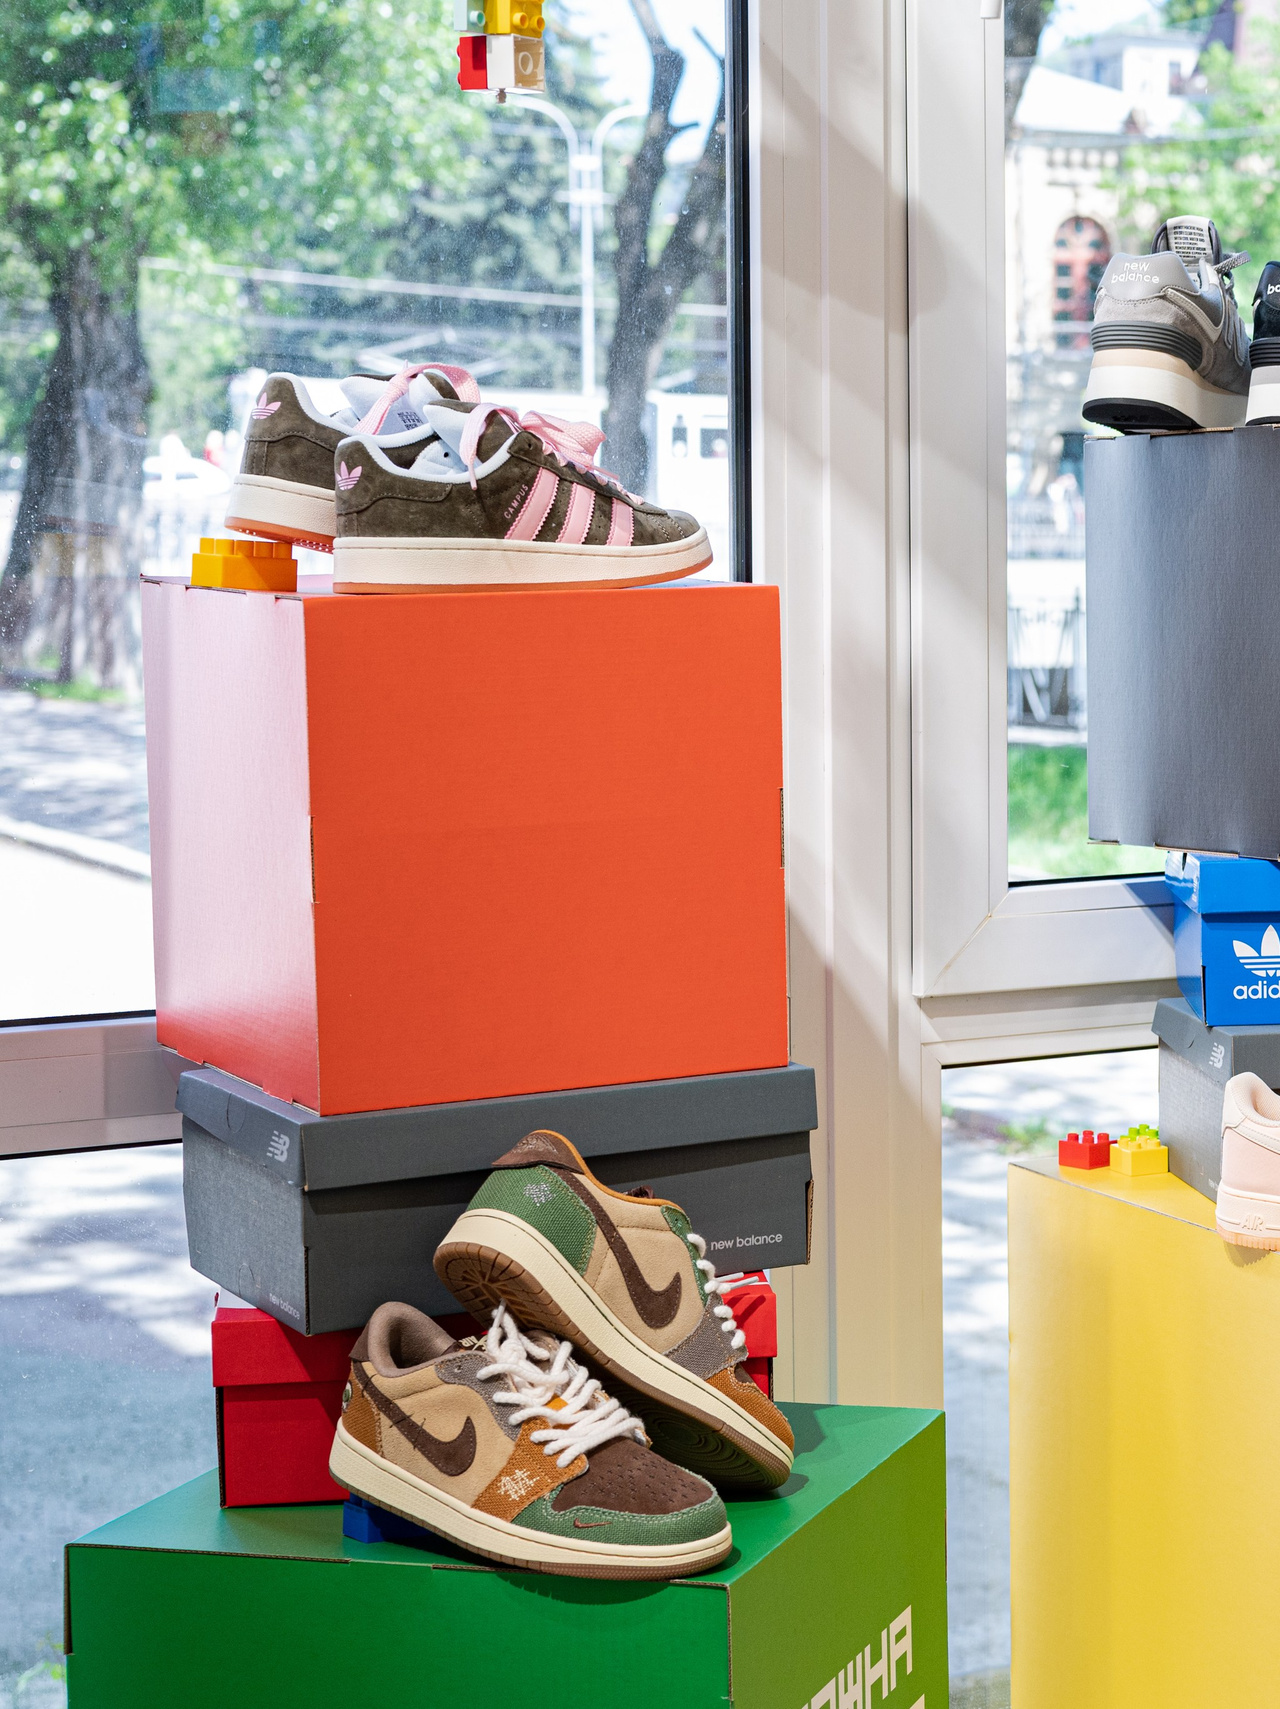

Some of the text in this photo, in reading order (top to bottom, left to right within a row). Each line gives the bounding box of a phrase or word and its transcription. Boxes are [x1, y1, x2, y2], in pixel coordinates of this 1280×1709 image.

[1123, 261, 1150, 272] new
[1111, 270, 1160, 284] balance
[503, 483, 529, 519] CAMPUS
[710, 1233, 783, 1251] new balance
[280, 1297, 301, 1320] balance
[459, 1335, 479, 1348] AIR
